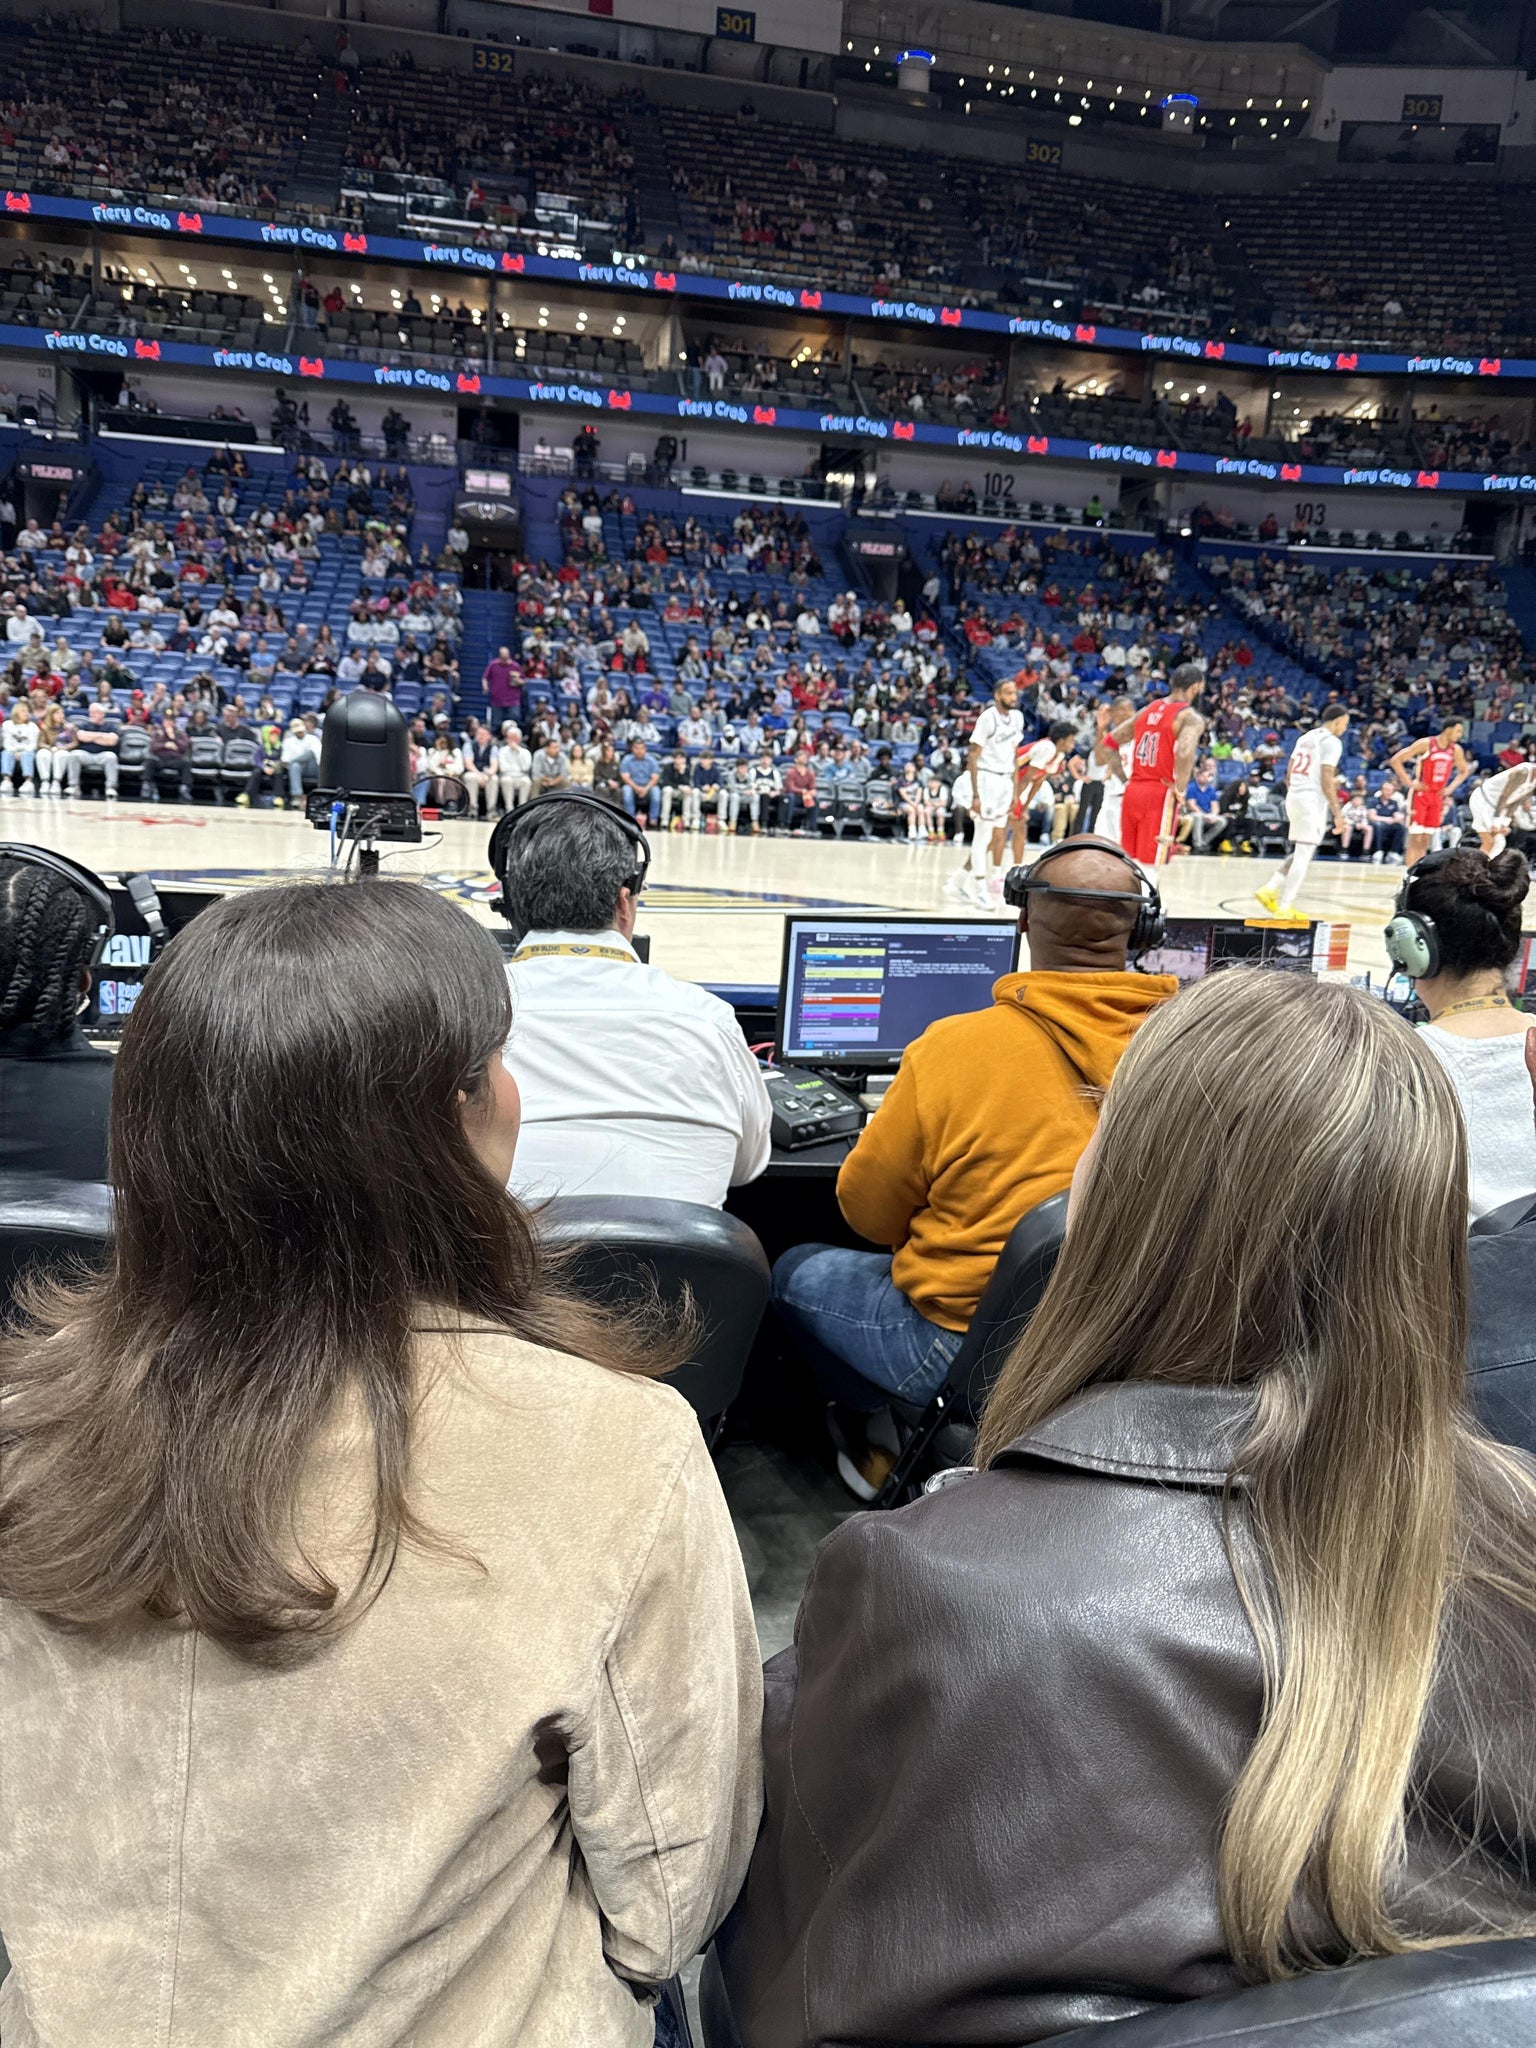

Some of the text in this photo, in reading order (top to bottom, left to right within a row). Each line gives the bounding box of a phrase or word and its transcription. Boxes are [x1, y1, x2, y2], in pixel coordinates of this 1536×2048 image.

[720, 13, 751, 35] 301
[474, 49, 513, 73] 332
[1404, 100, 1440, 116] 303
[1027, 143, 1061, 164] 302
[91, 204, 172, 230] Fiery Crab
[260, 223, 338, 250] Fiery Crab
[422, 244, 496, 270] Fiery Crab
[578, 263, 649, 289] Fiery Crab
[727, 282, 796, 307] Fiery Crab
[871, 300, 936, 324] Fiery Crab
[1008, 318, 1072, 341] Fiery Crab
[44, 331, 128, 357] Fiery Crab
[1140, 335, 1202, 357] Fiery Crab
[212, 349, 293, 375] Fiery Crab
[1267, 350, 1332, 370] Fiery Crab
[1407, 356, 1474, 375] Fiery Crab
[373, 366, 451, 392] Fiery Crab
[528, 383, 603, 408] Fiery Crab
[677, 399, 748, 423] Fiery Crab
[819, 415, 888, 438] Fiery Crab
[957, 430, 1023, 453] Fiery Crab
[1088, 444, 1153, 466] Fiery Crab
[1215, 458, 1277, 480] Fiery Crab
[1343, 468, 1412, 488] Fiery Crab
[984, 472, 1015, 498] 102
[1482, 475, 1536, 491] Fiery Cr
[1135, 730, 1161, 767] 41
[1291, 751, 1311, 776] 22
